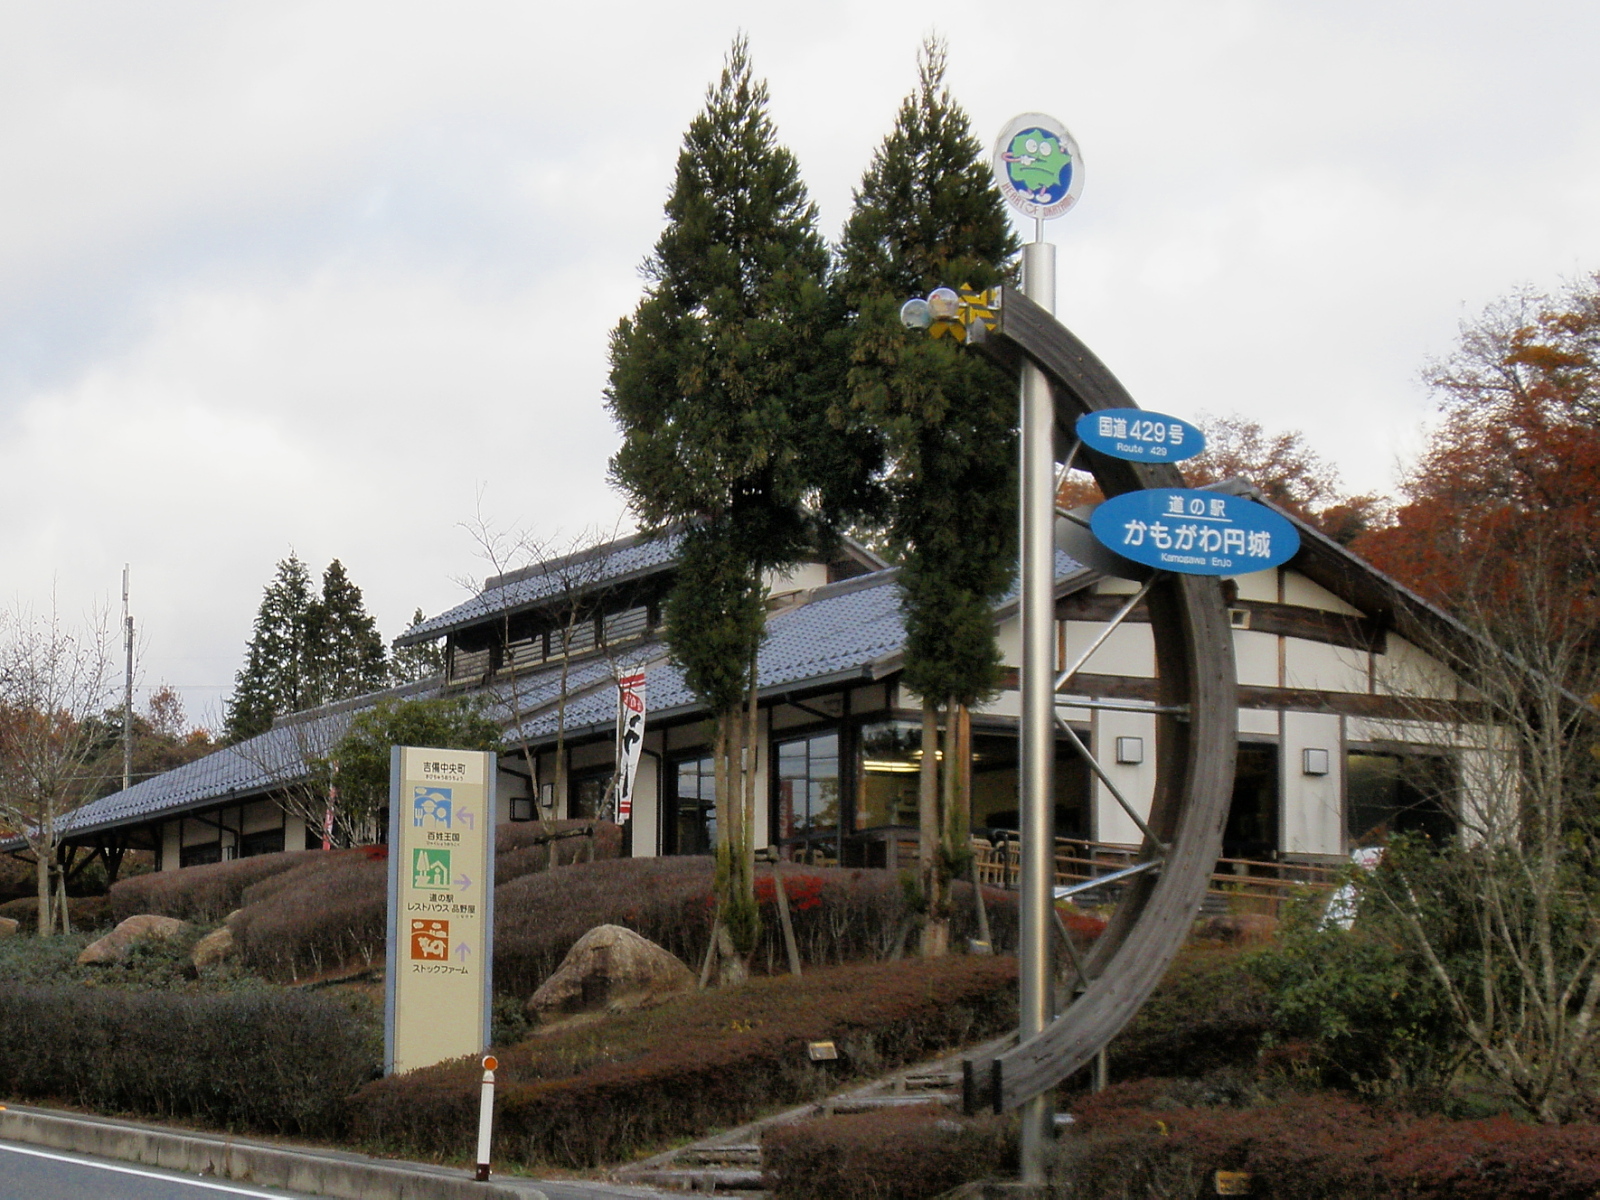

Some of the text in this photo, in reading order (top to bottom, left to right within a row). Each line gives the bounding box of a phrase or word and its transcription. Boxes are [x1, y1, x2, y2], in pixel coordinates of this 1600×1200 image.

[1116, 442, 1168, 456] Route 429
[1169, 495, 1226, 517] 道の駅
[1123, 519, 1271, 559] かもがわ円城
[1160, 552, 1206, 565] Kamogawa
[423, 761, 466, 775] 吉備中央町
[427, 831, 460, 842] 百姓王国
[429, 893, 454, 903] 道の駅
[407, 903, 450, 913] レストハウス
[412, 964, 469, 975] ストックファーム
